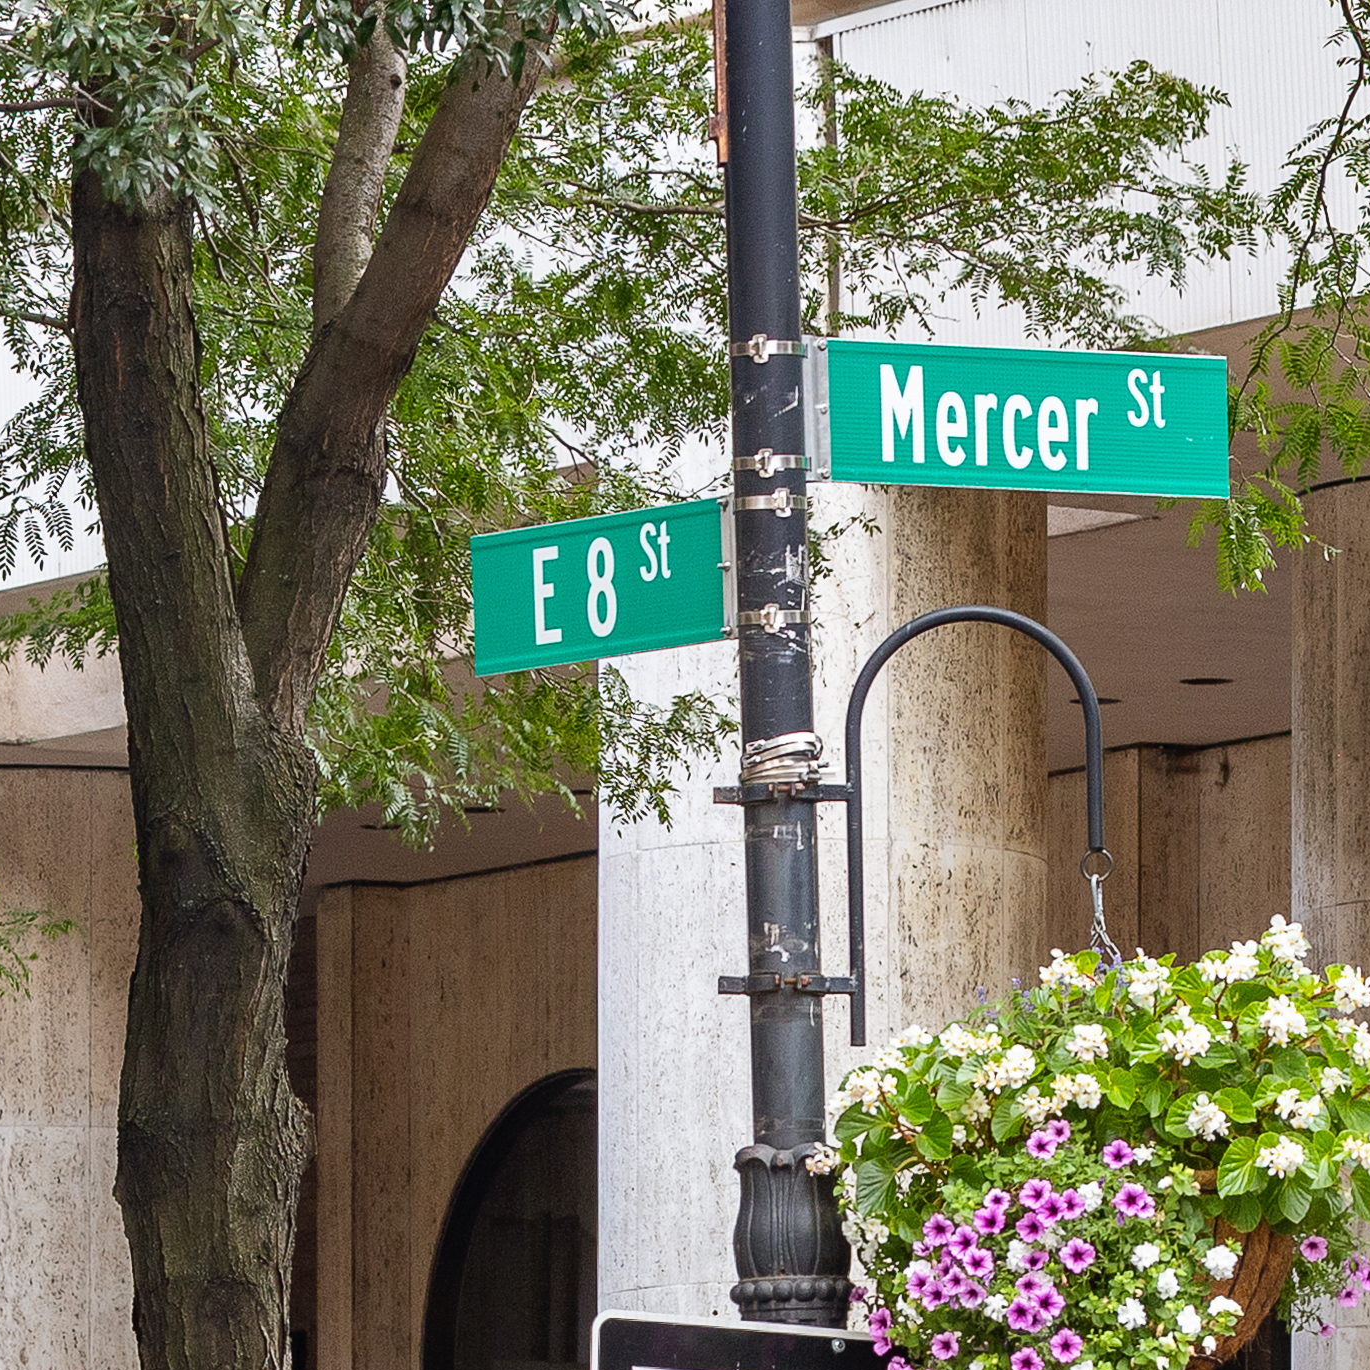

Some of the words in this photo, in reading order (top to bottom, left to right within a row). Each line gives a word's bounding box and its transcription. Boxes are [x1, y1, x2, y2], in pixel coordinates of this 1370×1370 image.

[878, 362, 1099, 472] Mercer
[1126, 367, 1167, 430] St
[531, 545, 563, 646] E
[585, 536, 618, 638] 8
[638, 521, 672, 583] St
